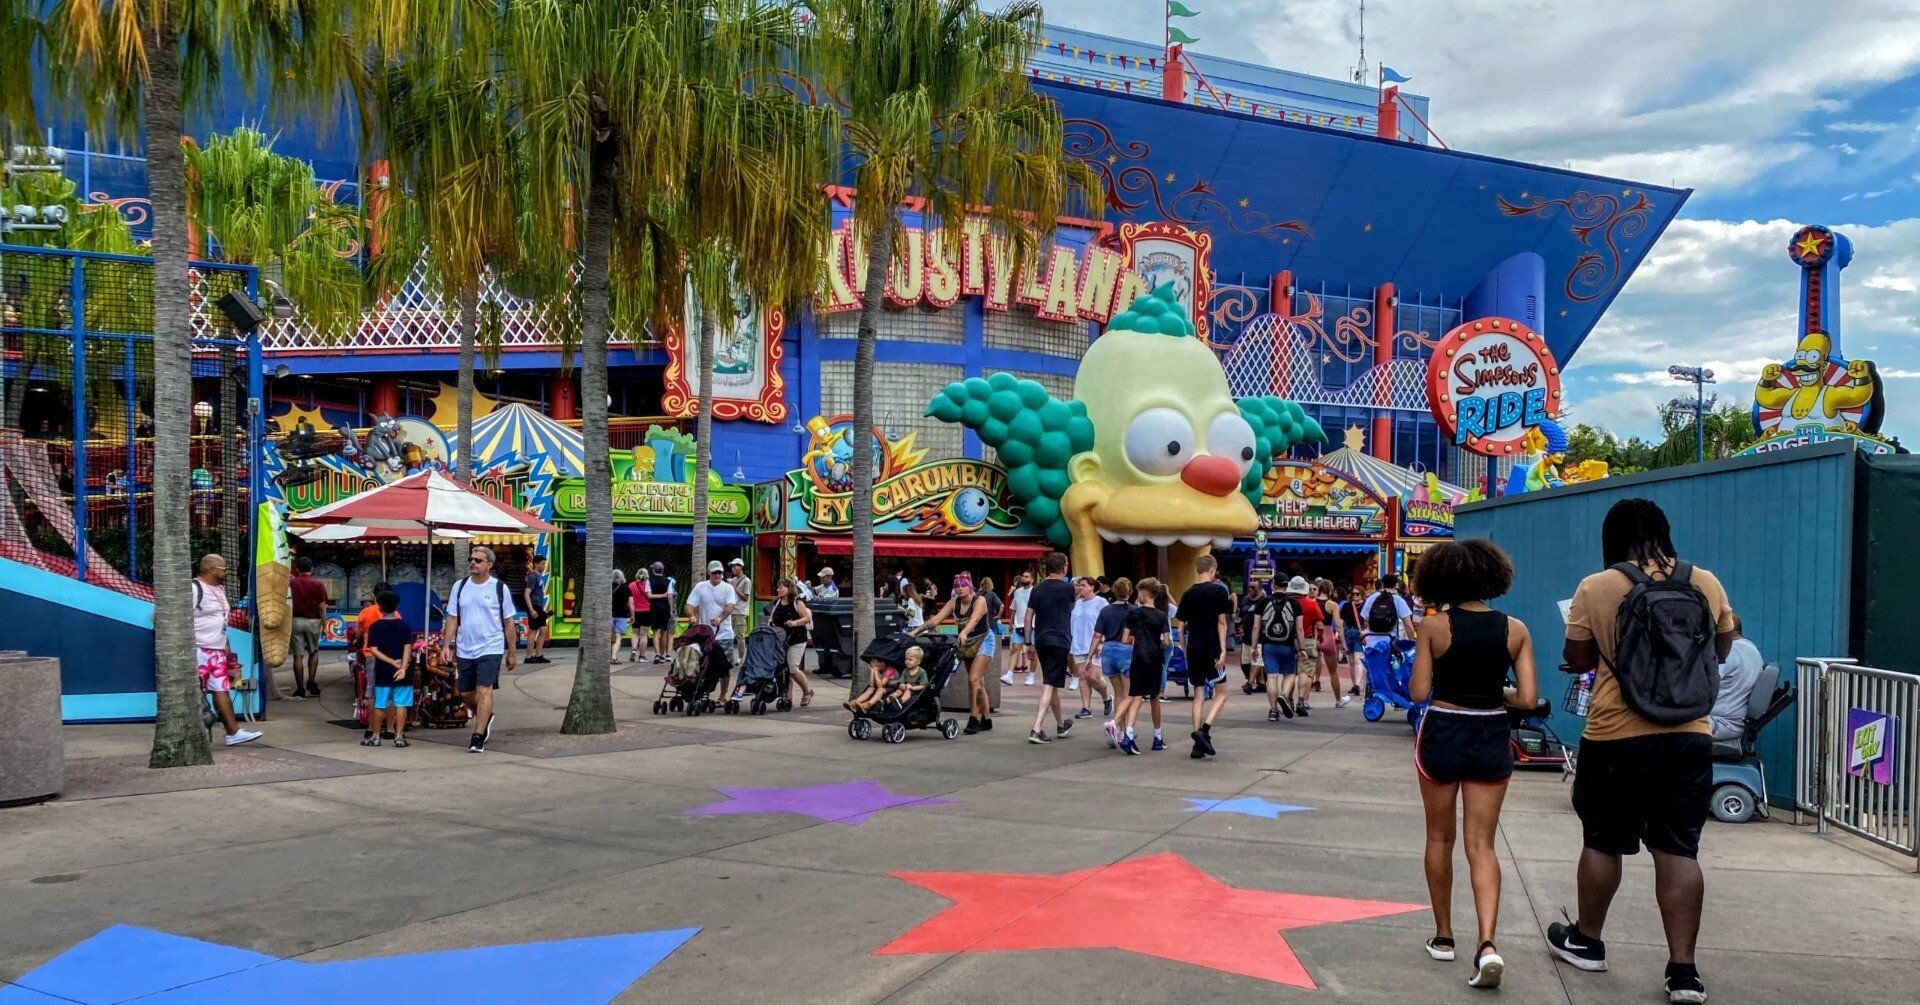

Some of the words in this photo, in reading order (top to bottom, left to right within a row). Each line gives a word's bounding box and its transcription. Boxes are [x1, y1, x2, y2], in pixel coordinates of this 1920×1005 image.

[1454, 353, 1538, 395] SIMPSONS
[1453, 387, 1546, 446] RIDE
[813, 497, 853, 525] EY
[872, 463, 1006, 516] CARUMBA!
[1292, 480, 1300, 490] 8
[1276, 500, 1307, 513] HELP
[1275, 515, 1313, 528] LITTLE
[1315, 516, 1358, 529] HELPER
